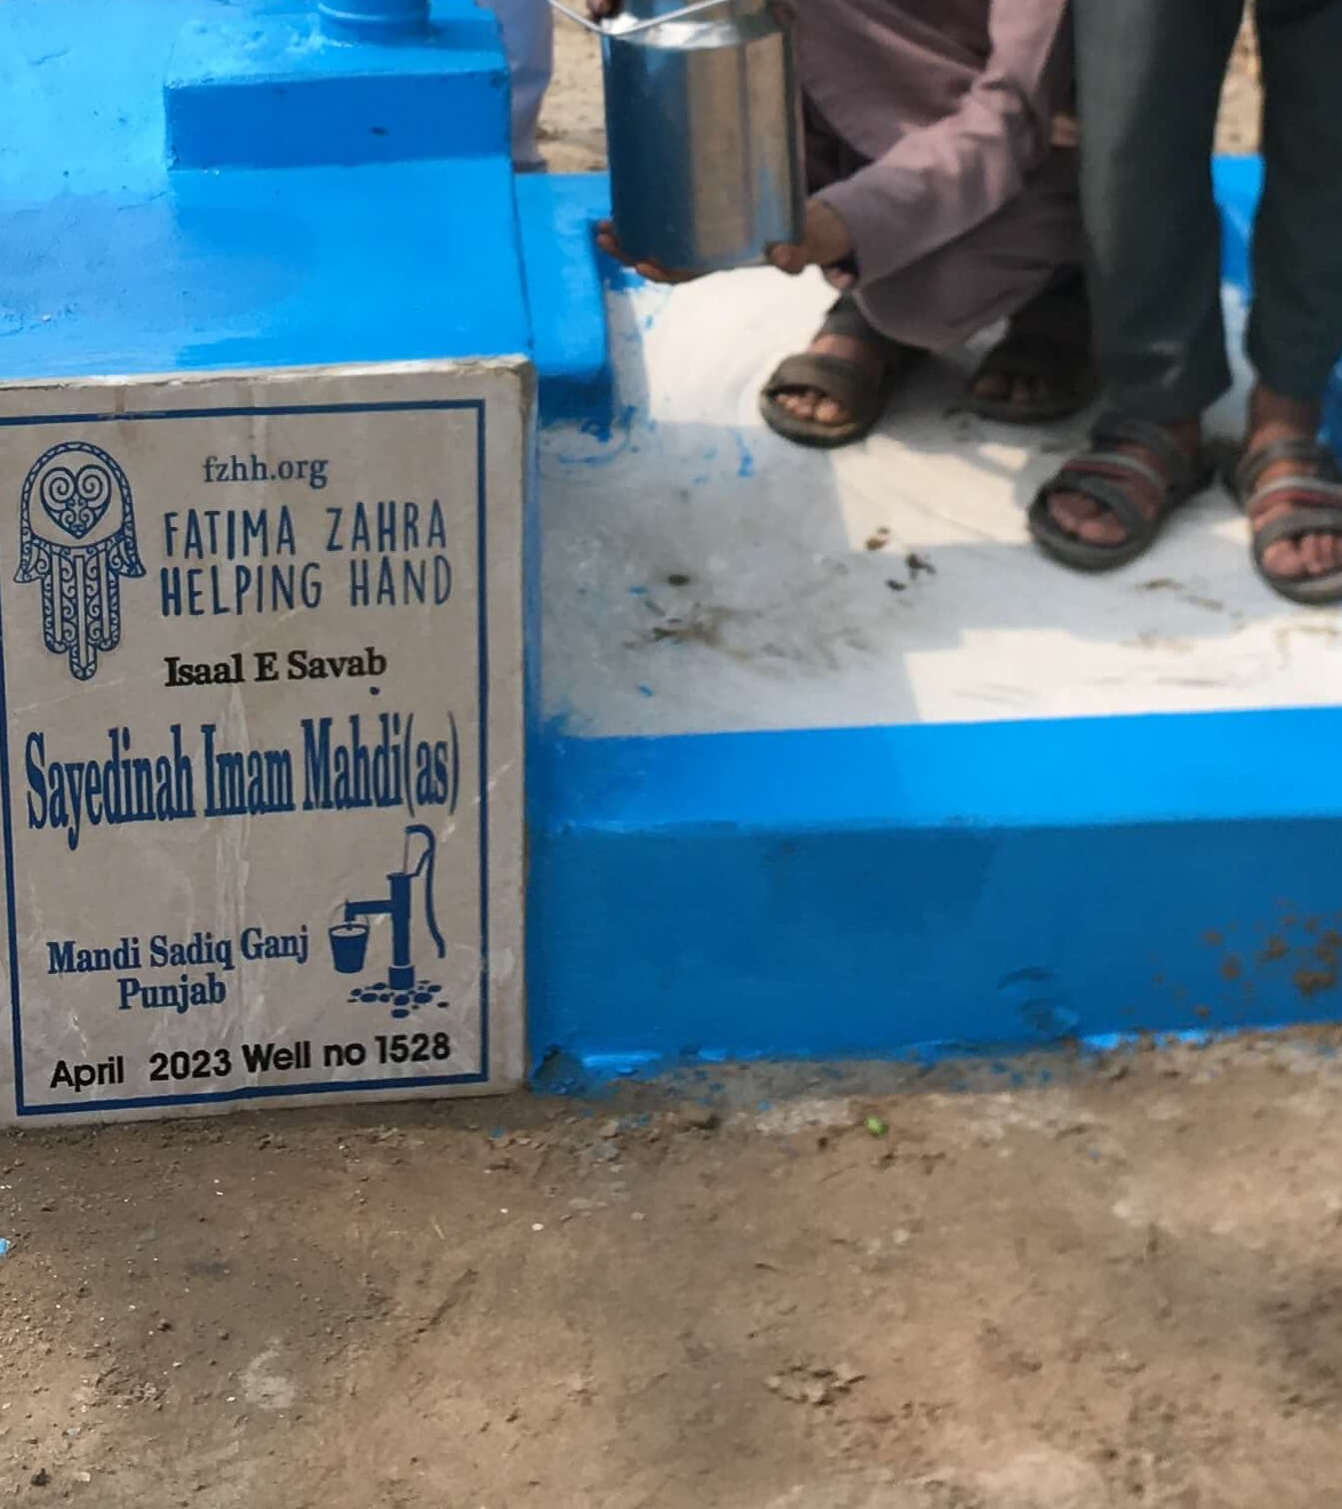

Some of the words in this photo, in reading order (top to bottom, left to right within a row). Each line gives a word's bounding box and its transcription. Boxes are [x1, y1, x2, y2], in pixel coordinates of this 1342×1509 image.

[202, 454, 329, 488] fzhh.org
[164, 506, 296, 559] FATIMA
[326, 500, 447, 552] ZAHRA
[160, 562, 322, 617] HELPING
[350, 555, 452, 607] HAND
[164, 654, 245, 686] Isaal
[254, 652, 278, 681] E
[287, 647, 387, 680] Savab
[25, 724, 195, 851] Sayedinah
[201, 725, 295, 817] Imam
[301, 712, 459, 816] Mahdi(as)
[47, 937, 142, 974] Mandi
[149, 931, 234, 970] Sadiq
[240, 926, 309, 964] Ganj
[117, 972, 227, 1014] Punjab
[50, 1056, 125, 1092] April
[149, 1048, 232, 1081] 2023
[241, 1040, 312, 1073] Well
[323, 1041, 366, 1068] no
[374, 1032, 451, 1065] 1528
